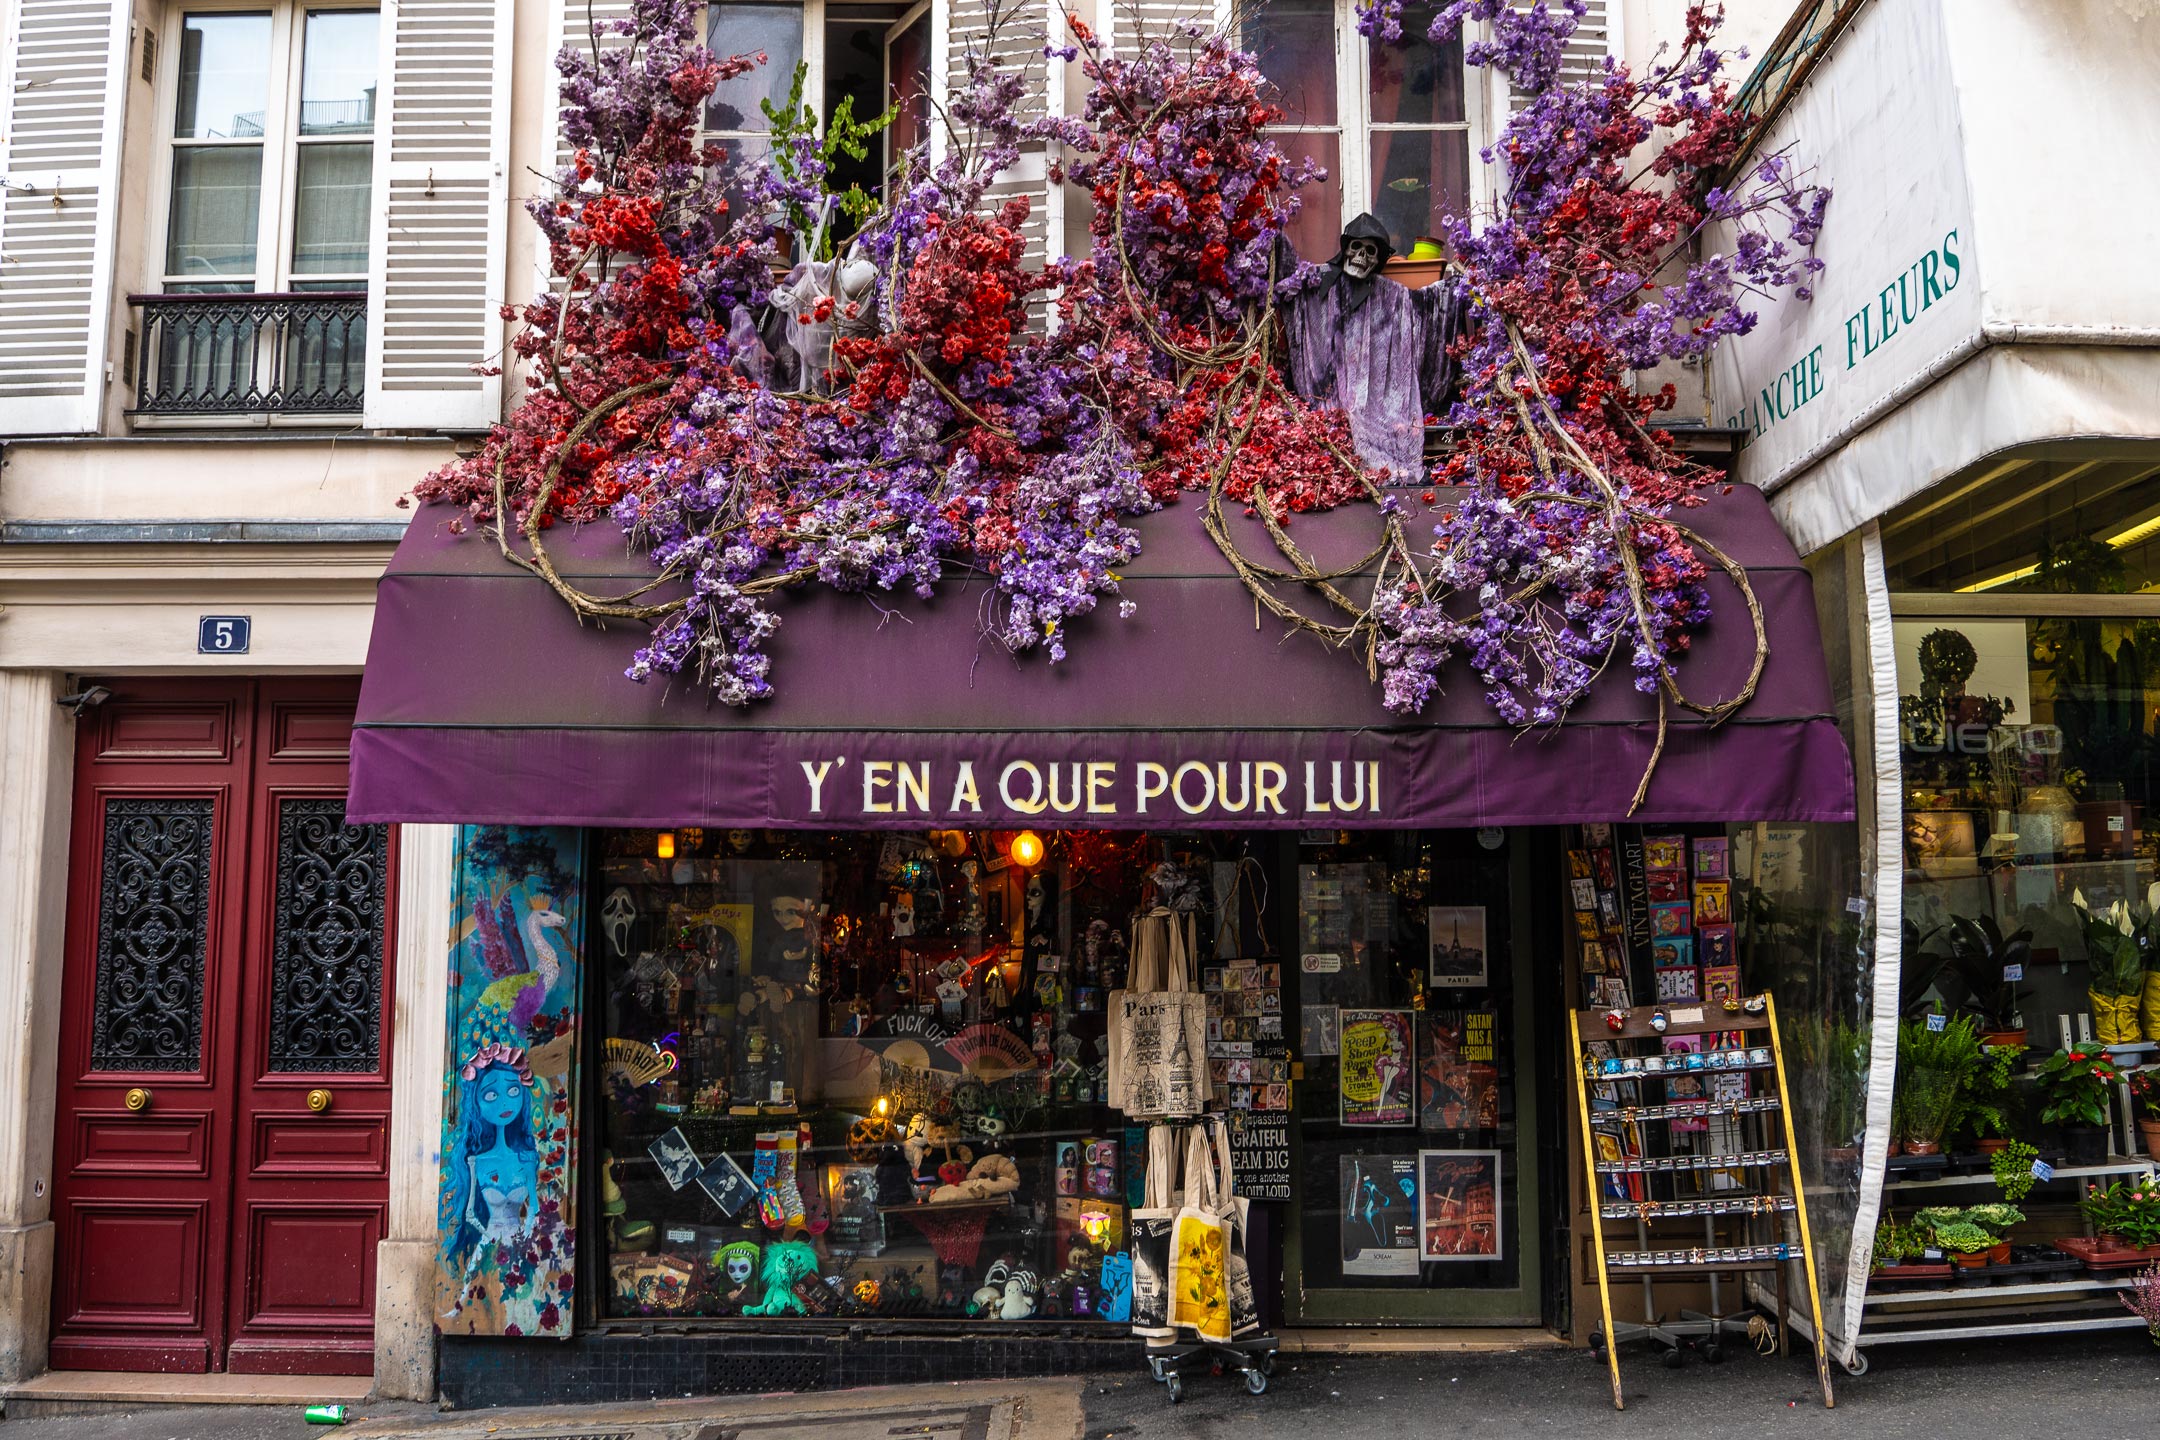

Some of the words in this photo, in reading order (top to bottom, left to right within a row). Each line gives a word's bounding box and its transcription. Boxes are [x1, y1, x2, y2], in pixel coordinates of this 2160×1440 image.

[1845, 228, 1960, 370] FLEURS
[215, 621, 233, 649] 5
[863, 761, 930, 813] EN
[950, 761, 982, 812] A
[998, 761, 1116, 814] QUE
[1136, 761, 1287, 814] POUR
[1305, 761, 1380, 812] LUI
[886, 1013, 925, 1035] FUCK
[1466, 1013, 1493, 1030] SATAN
[989, 1034, 1000, 1048] DE
[1346, 1035, 1377, 1050] Peep
[1466, 1030, 1484, 1046] WAS
[1485, 1030, 1493, 1046] A
[1264, 1045, 1285, 1056] loved
[1349, 1047, 1381, 1060] Shows
[1459, 1046, 1493, 1061] LESBIAN
[632, 1051, 658, 1073] HOT
[1347, 1082, 1373, 1091] STORM
[1232, 1129, 1289, 1147] GRATEFUL
[1231, 1151, 1263, 1170] EAM
[1265, 1151, 1289, 1170] BIG
[1243, 1174, 1257, 1183] one
[1260, 1172, 1289, 1183] another
[1265, 1185, 1291, 1198] LOUD
